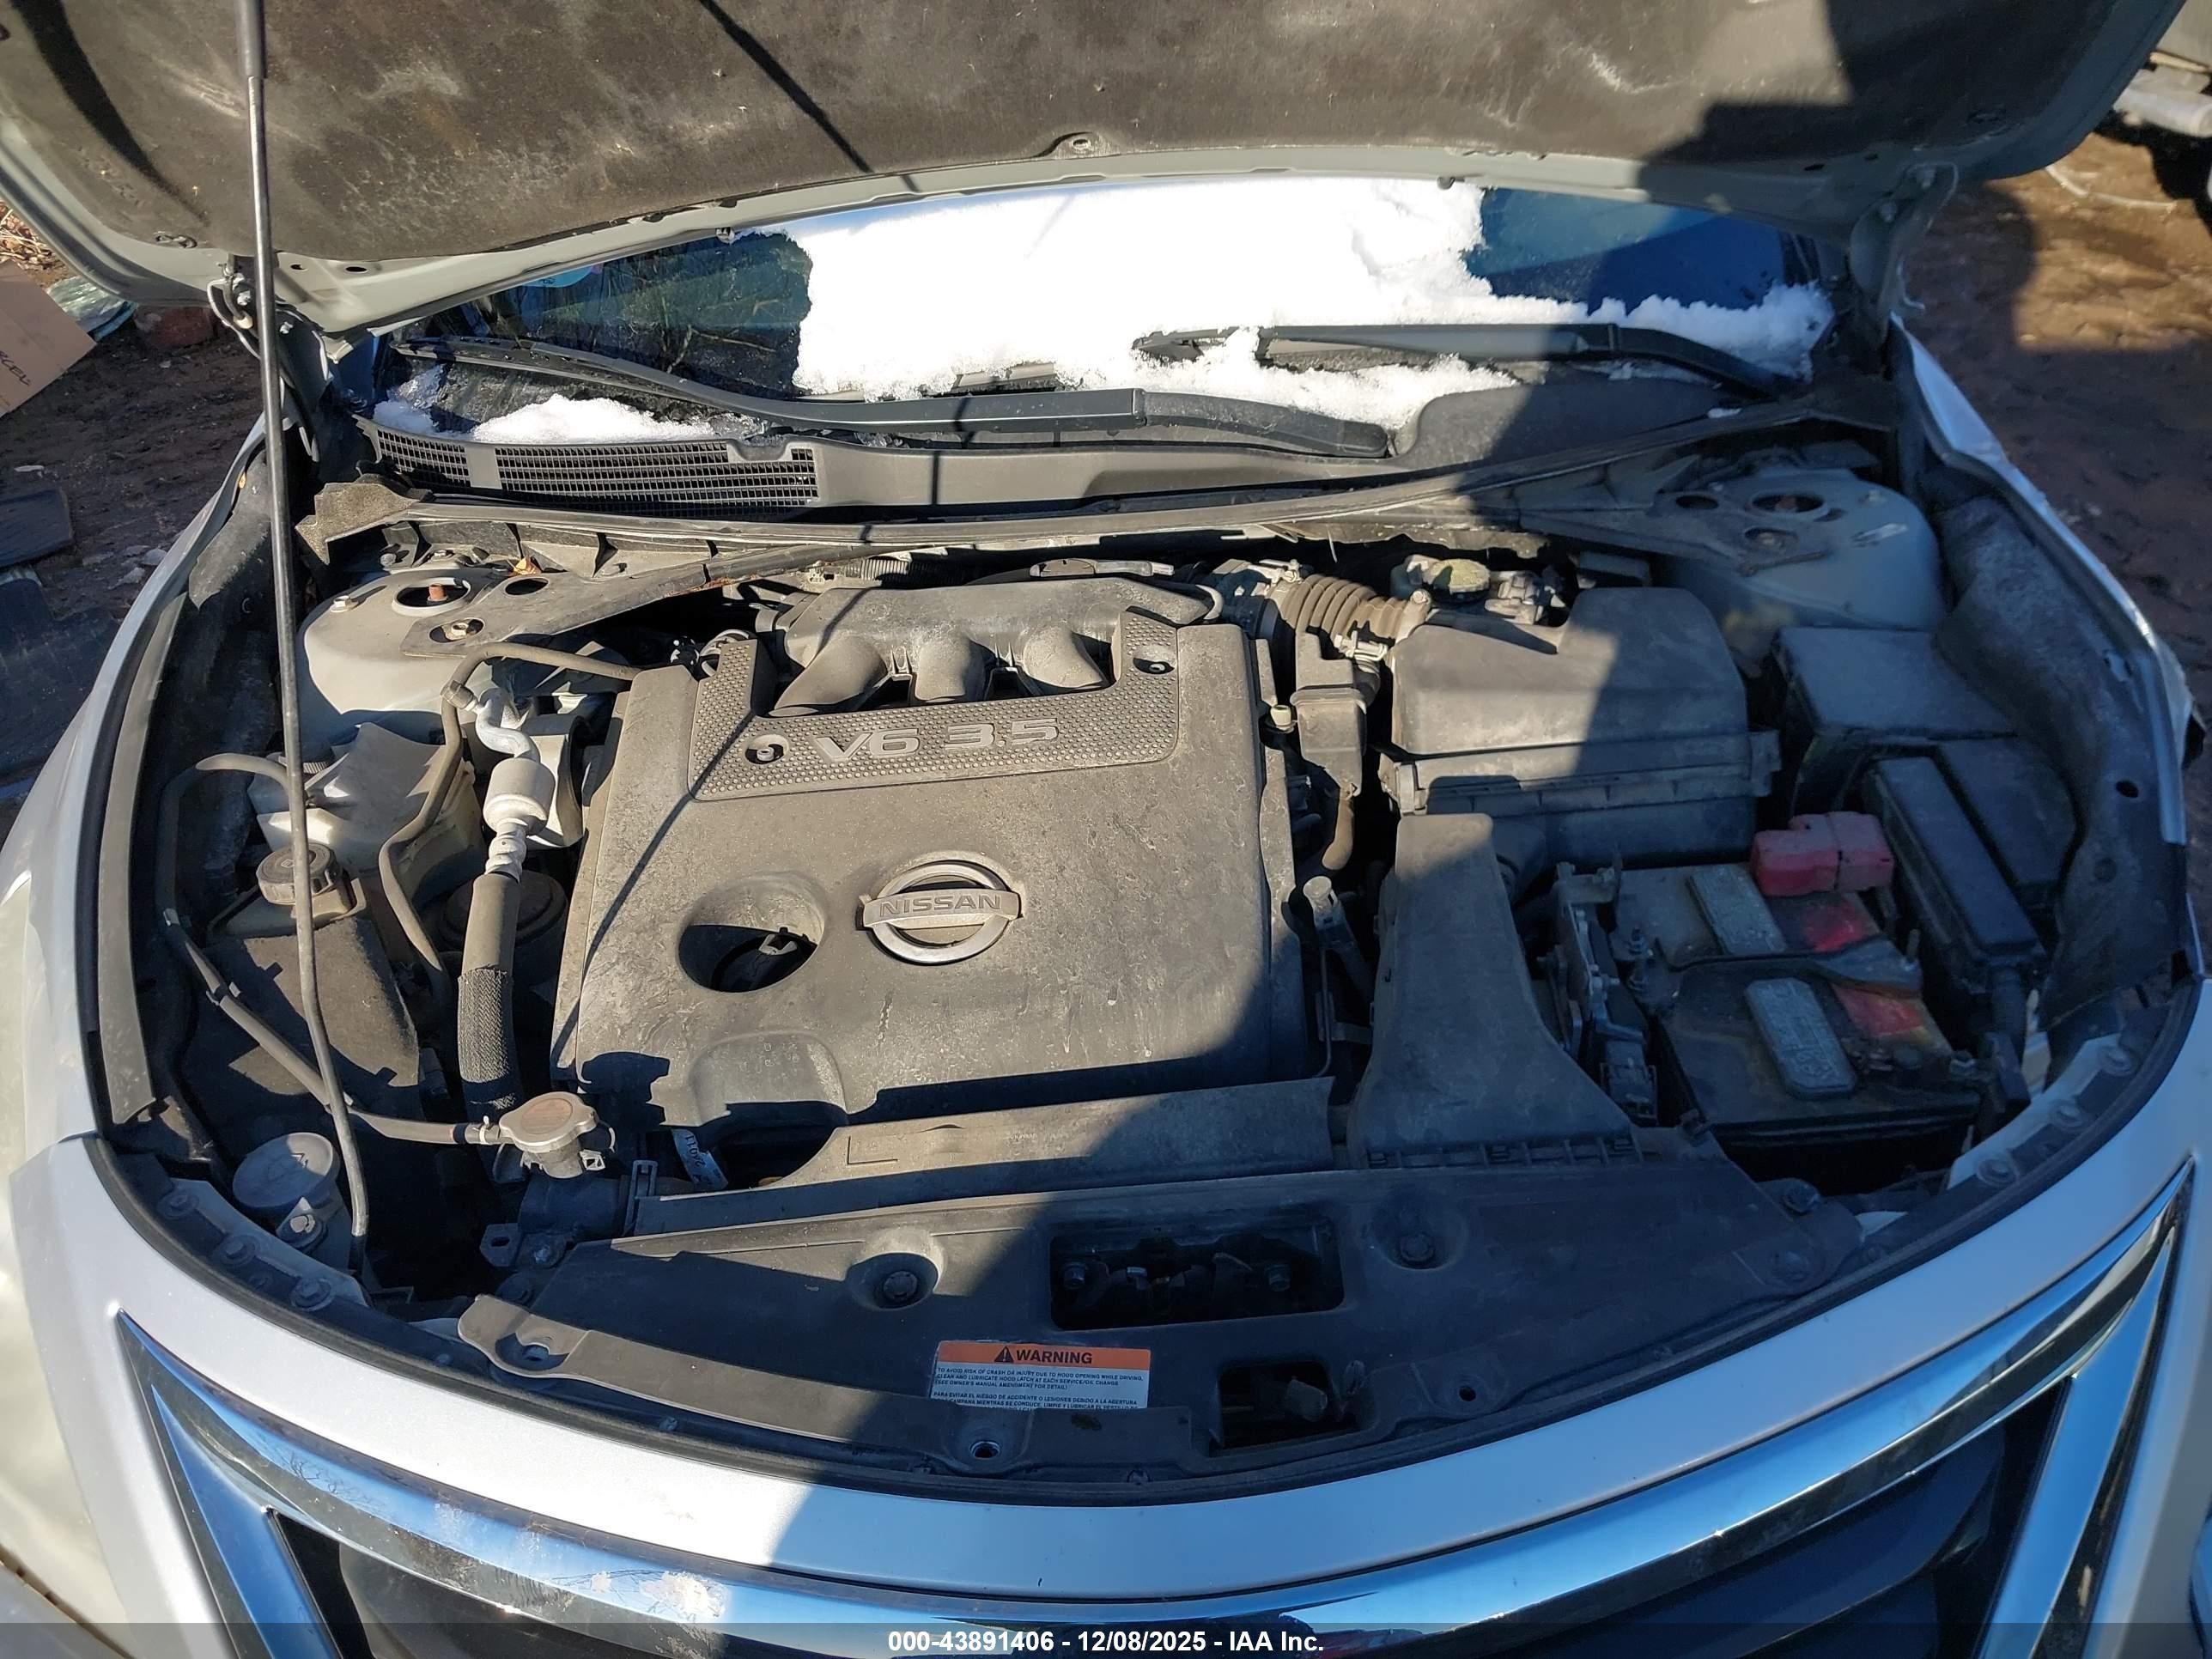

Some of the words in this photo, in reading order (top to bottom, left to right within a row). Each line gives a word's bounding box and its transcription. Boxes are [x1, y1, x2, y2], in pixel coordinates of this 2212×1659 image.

[816, 728, 919, 763] V6
[943, 716, 1059, 750] 3.5
[879, 895, 1001, 917] NISSAN
[1016, 1349, 1092, 1364] WARNING
